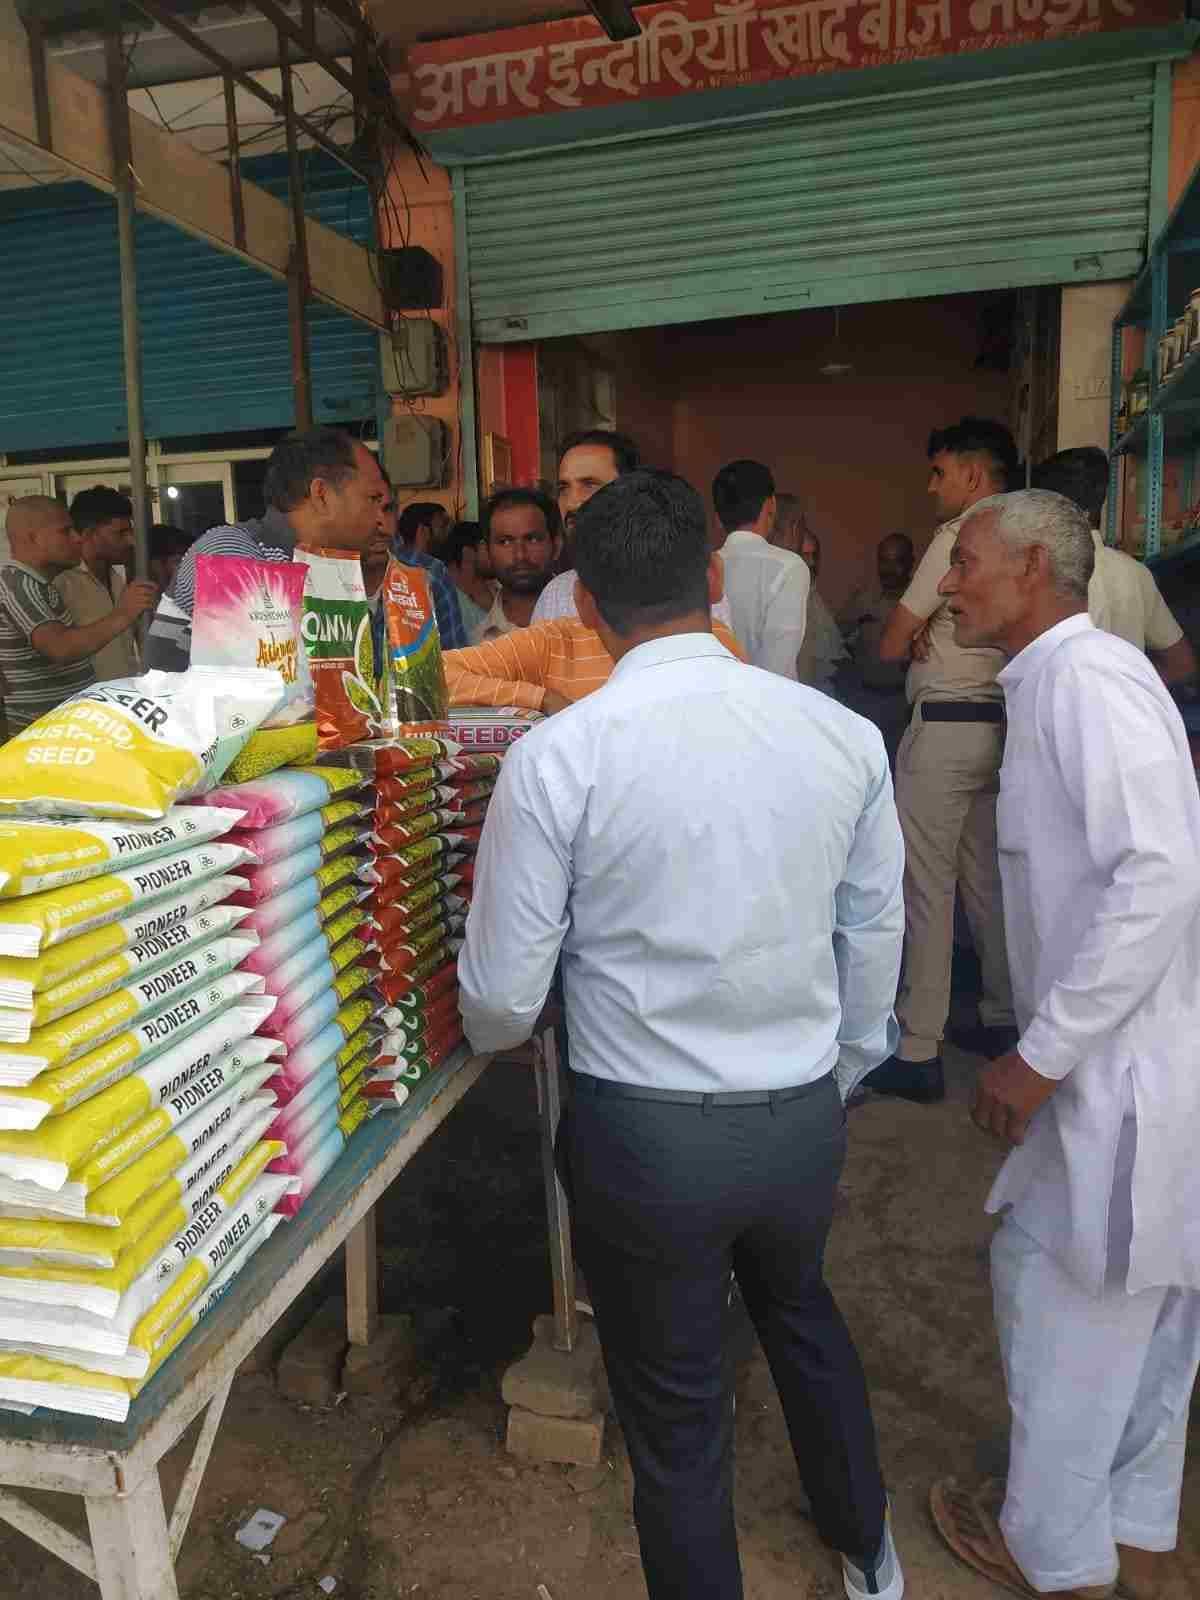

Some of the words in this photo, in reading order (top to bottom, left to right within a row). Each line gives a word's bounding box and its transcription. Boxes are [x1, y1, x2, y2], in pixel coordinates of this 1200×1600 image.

[413, 46, 543, 122] अमर
[760, 5, 851, 67] खाद
[857, 0, 951, 50] बीज
[25, 745, 96, 767] SEED
[113, 826, 177, 853] PIONEER
[134, 859, 192, 894] PIONEER
[130, 924, 192, 962] PIONEER
[139, 960, 198, 1001] PIONEER
[142, 999, 201, 1043] PIONEER
[159, 1053, 211, 1102] PIONEER
[171, 1067, 225, 1115] PIONEER
[192, 1106, 232, 1152] PIONEER
[174, 1201, 222, 1257] PIONEER
[209, 1213, 251, 1267] PIONEER
